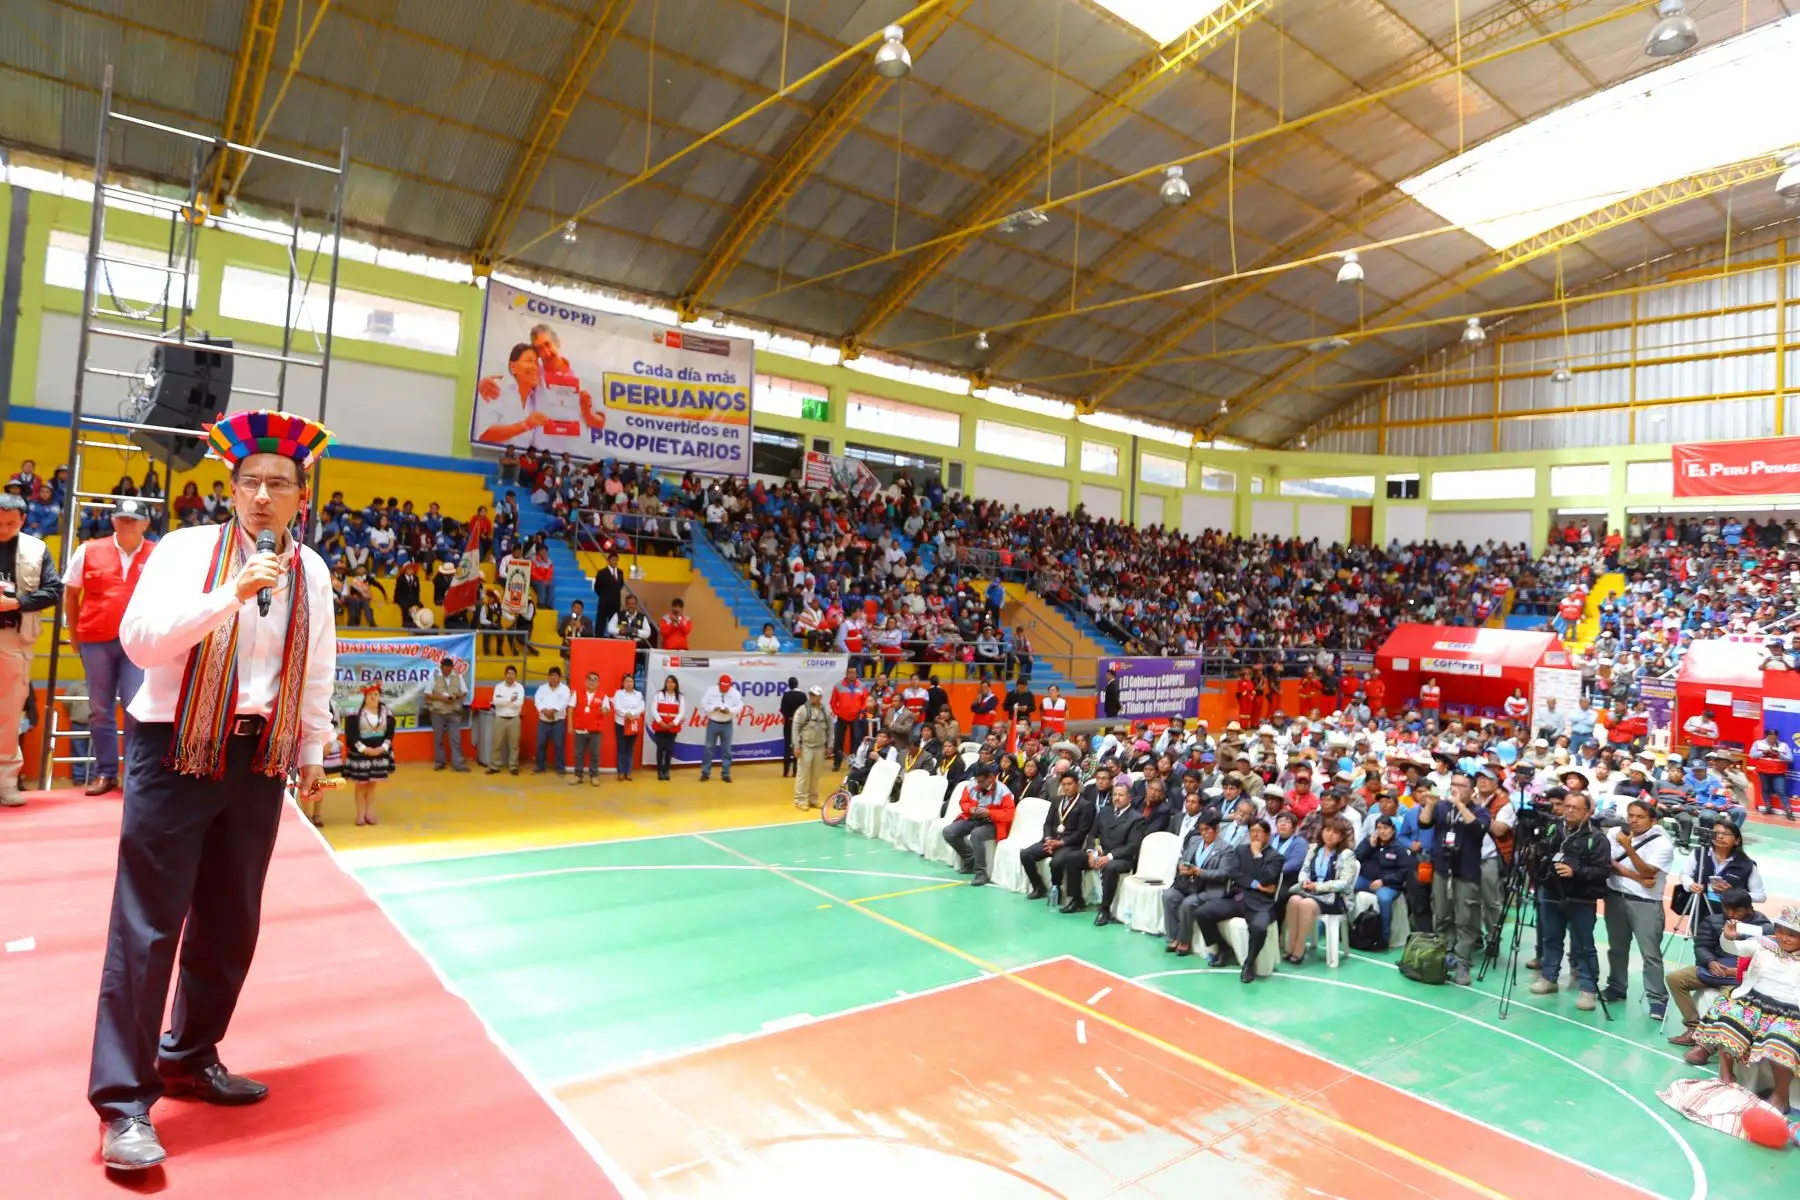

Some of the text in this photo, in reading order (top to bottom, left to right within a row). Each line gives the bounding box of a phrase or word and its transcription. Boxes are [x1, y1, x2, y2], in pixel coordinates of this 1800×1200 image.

[527, 299, 596, 327] COFOPRI
[633, 361, 737, 384] Cada día más
[610, 381, 747, 412] PERUANOS
[625, 415, 739, 439] convertidos en
[590, 427, 741, 461] PROPIETARIOS
[807, 658, 837, 667] COFOPRI
[361, 669, 431, 681] BARBAR
